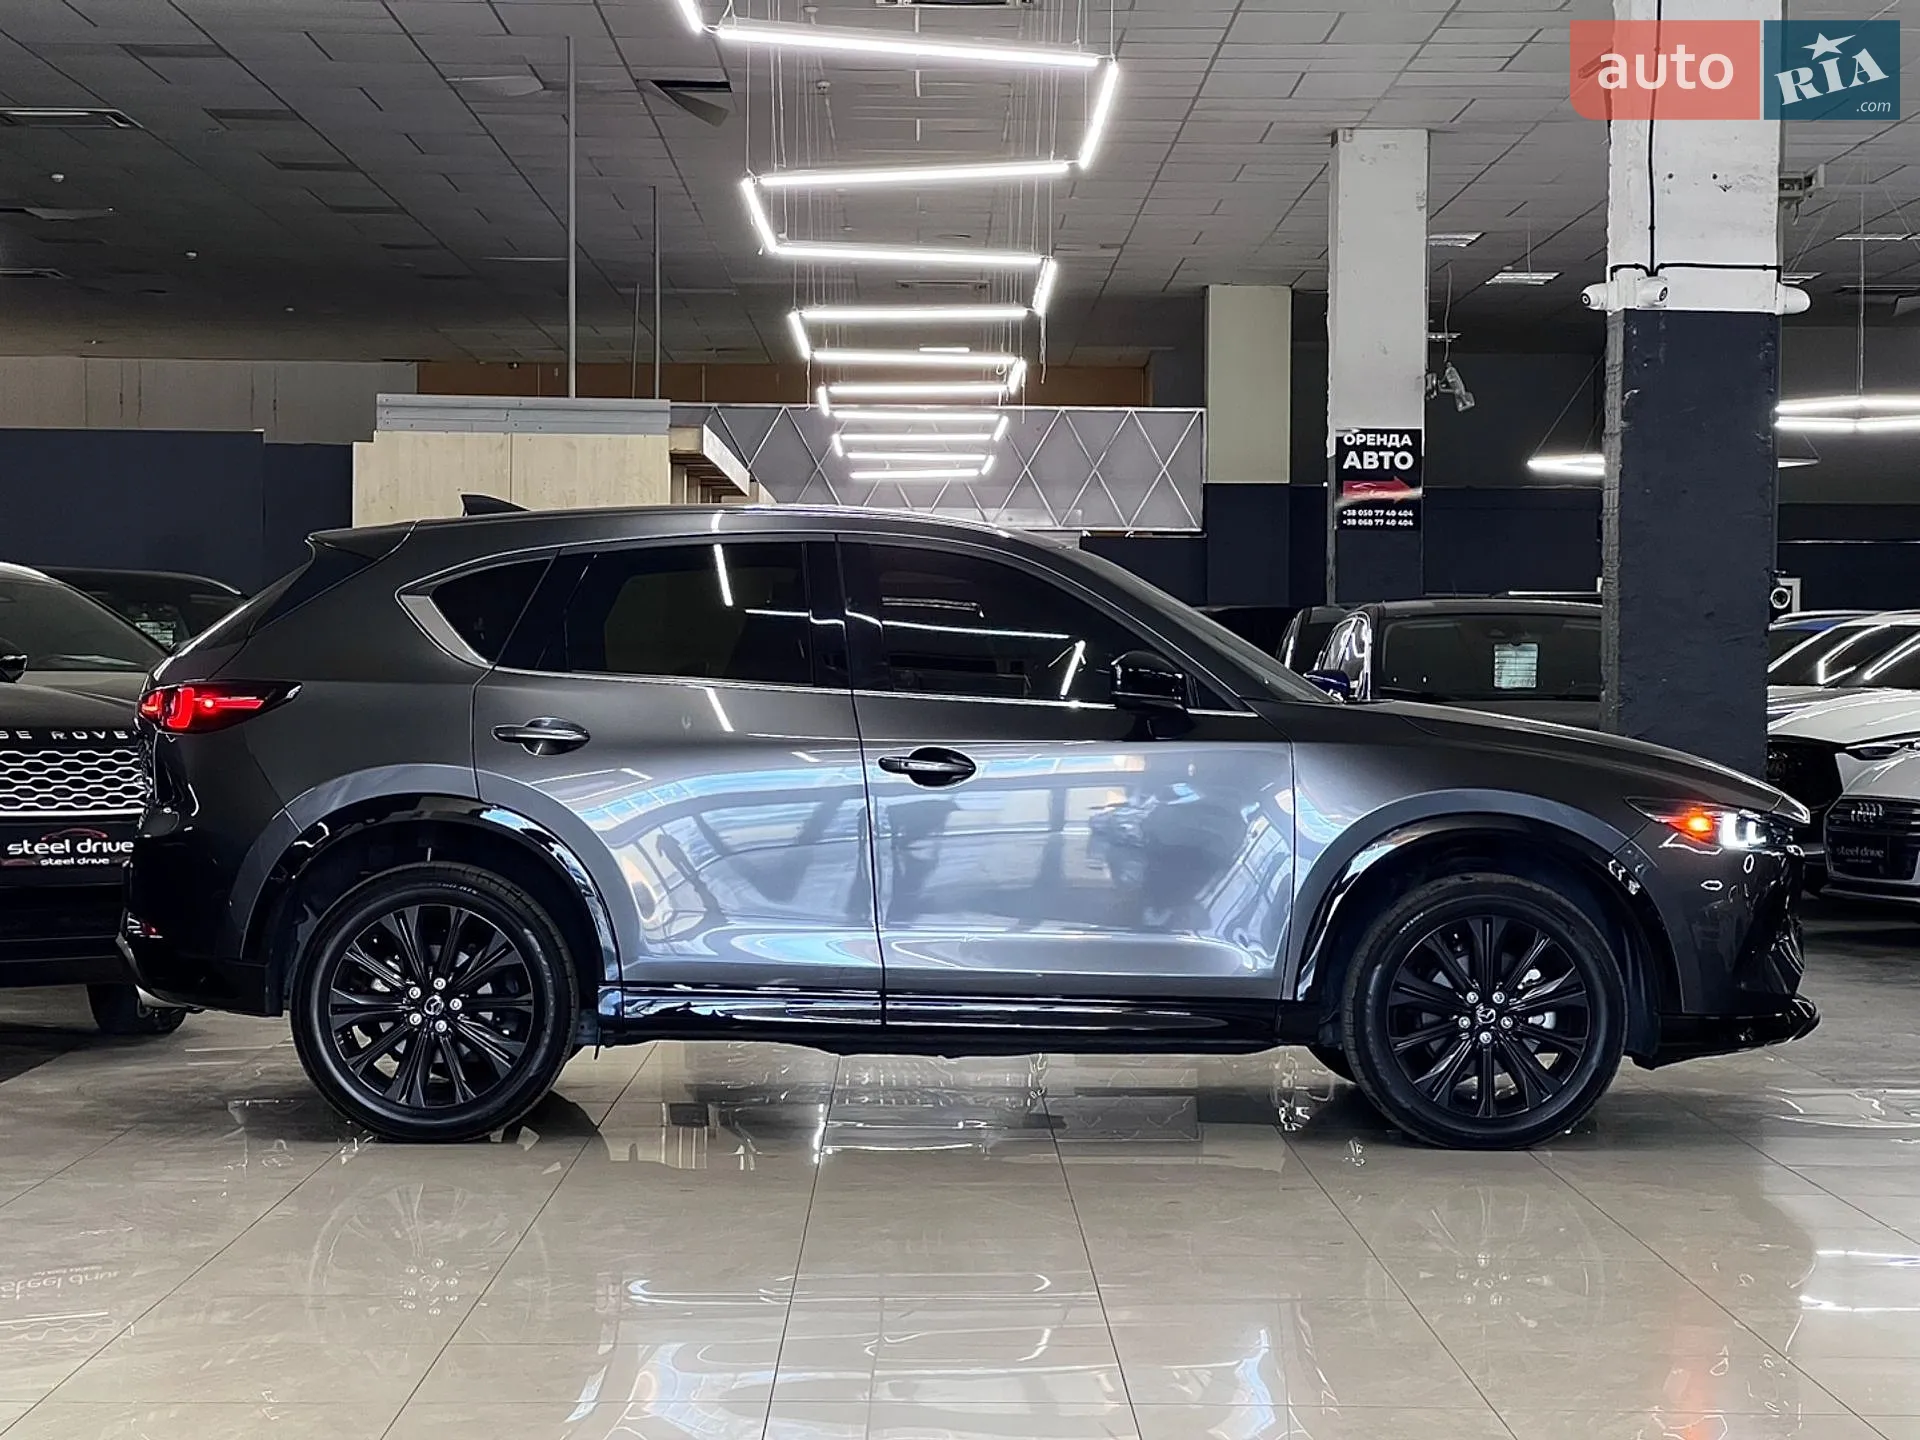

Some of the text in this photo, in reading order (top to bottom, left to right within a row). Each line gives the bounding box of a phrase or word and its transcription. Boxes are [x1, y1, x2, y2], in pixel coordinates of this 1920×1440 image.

[1343, 433, 1413, 448] ОРЕНДА
[1342, 450, 1414, 470] АВТО
[1374, 509, 1385, 517] 77
[1374, 518, 1385, 526] 77
[50, 730, 137, 740] ROVE
[7, 838, 135, 855] steel drive
[40, 857, 110, 866] steel drive
